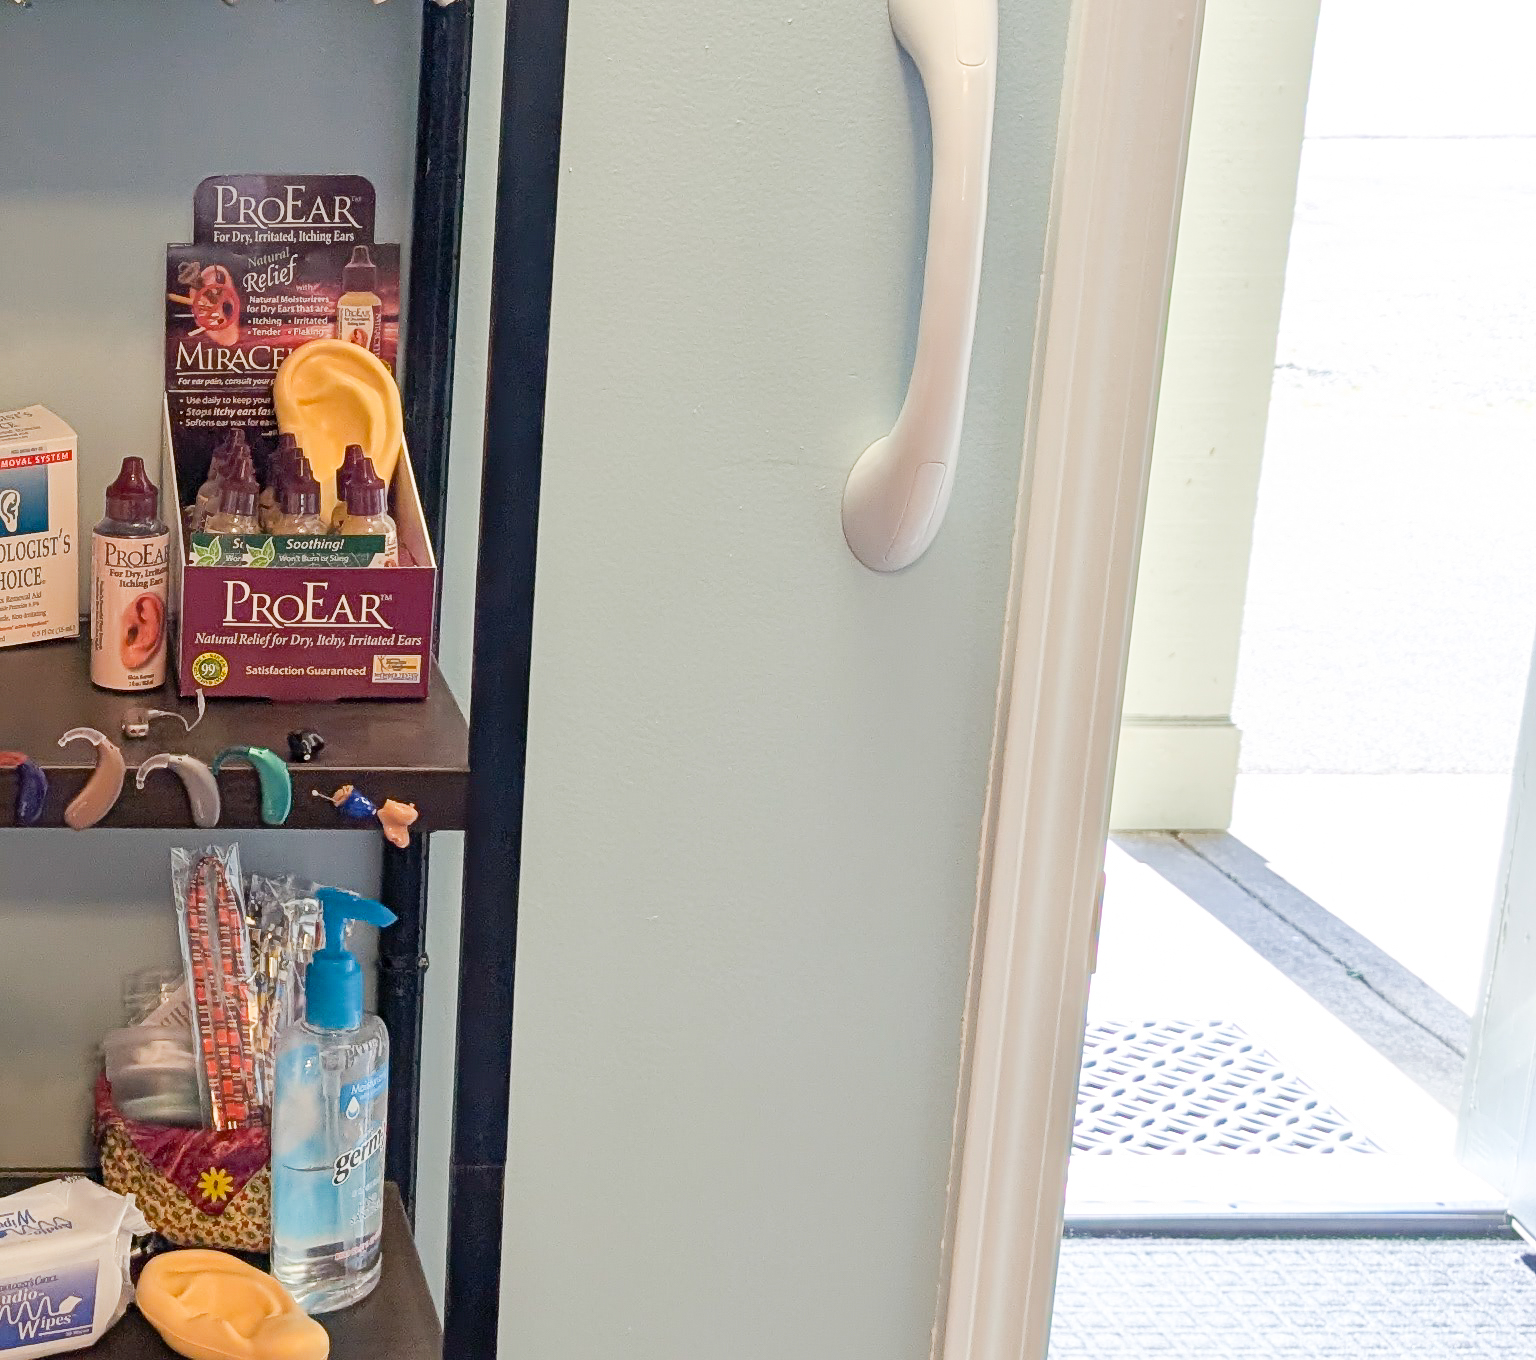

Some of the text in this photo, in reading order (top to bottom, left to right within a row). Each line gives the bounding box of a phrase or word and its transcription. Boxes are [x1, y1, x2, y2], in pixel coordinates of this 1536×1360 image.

[214, 230, 355, 245] For Dry, Irritated, Itching Ears
[248, 247, 290, 269] Natural
[243, 254, 298, 293] Relief
[249, 295, 330, 304] Natural Moisturizers
[247, 305, 313, 315] for Dry Ears that
[252, 317, 328, 327] Itching Irritated
[252, 328, 281, 336] Tender
[176, 341, 290, 374] MIRACE
[178, 377, 191, 385] For
[186, 396, 201, 404] Use
[202, 396, 221, 406] daily
[232, 396, 252, 406] keep
[252, 397, 271, 406] your
[186, 407, 256, 418] Stops itchy ears
[185, 419, 215, 427] Softens
[35, 451, 69, 464] SYSTEM
[286, 538, 345, 553] Soothing!
[194, 632, 422, 648] Natural Relief for Dry, Itchy, Irritated Ears
[245, 665, 305, 677] Satisfaction
[306, 665, 367, 677] Guaranteed
[18, 1314, 72, 1340] Wipes
